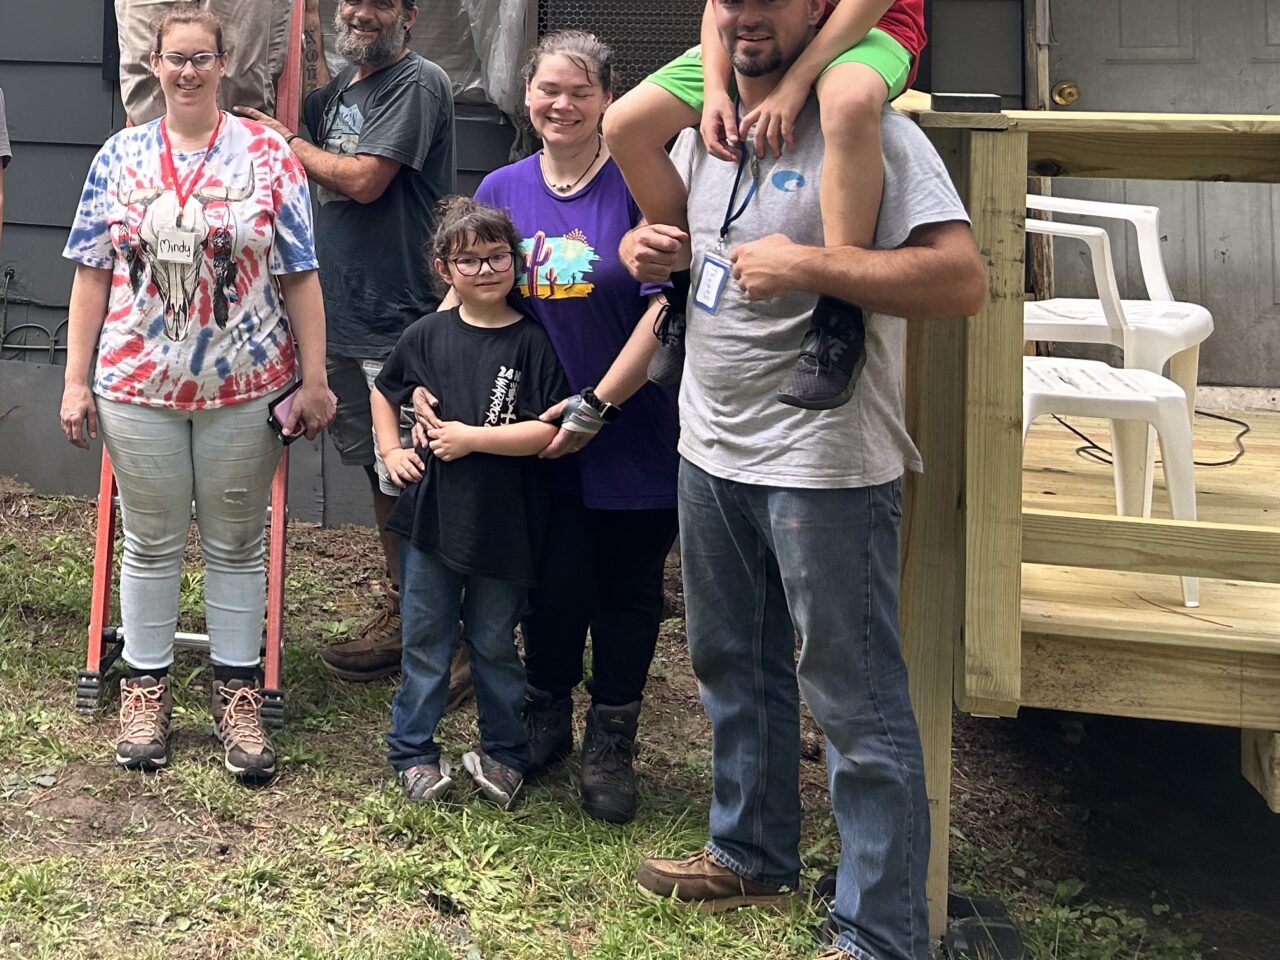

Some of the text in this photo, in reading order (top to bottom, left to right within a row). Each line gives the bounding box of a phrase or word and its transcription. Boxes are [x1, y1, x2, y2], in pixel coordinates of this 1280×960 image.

[160, 239, 191, 257] Mindy
[498, 365, 514, 380] 24
[485, 377, 509, 424] WARRIOR
